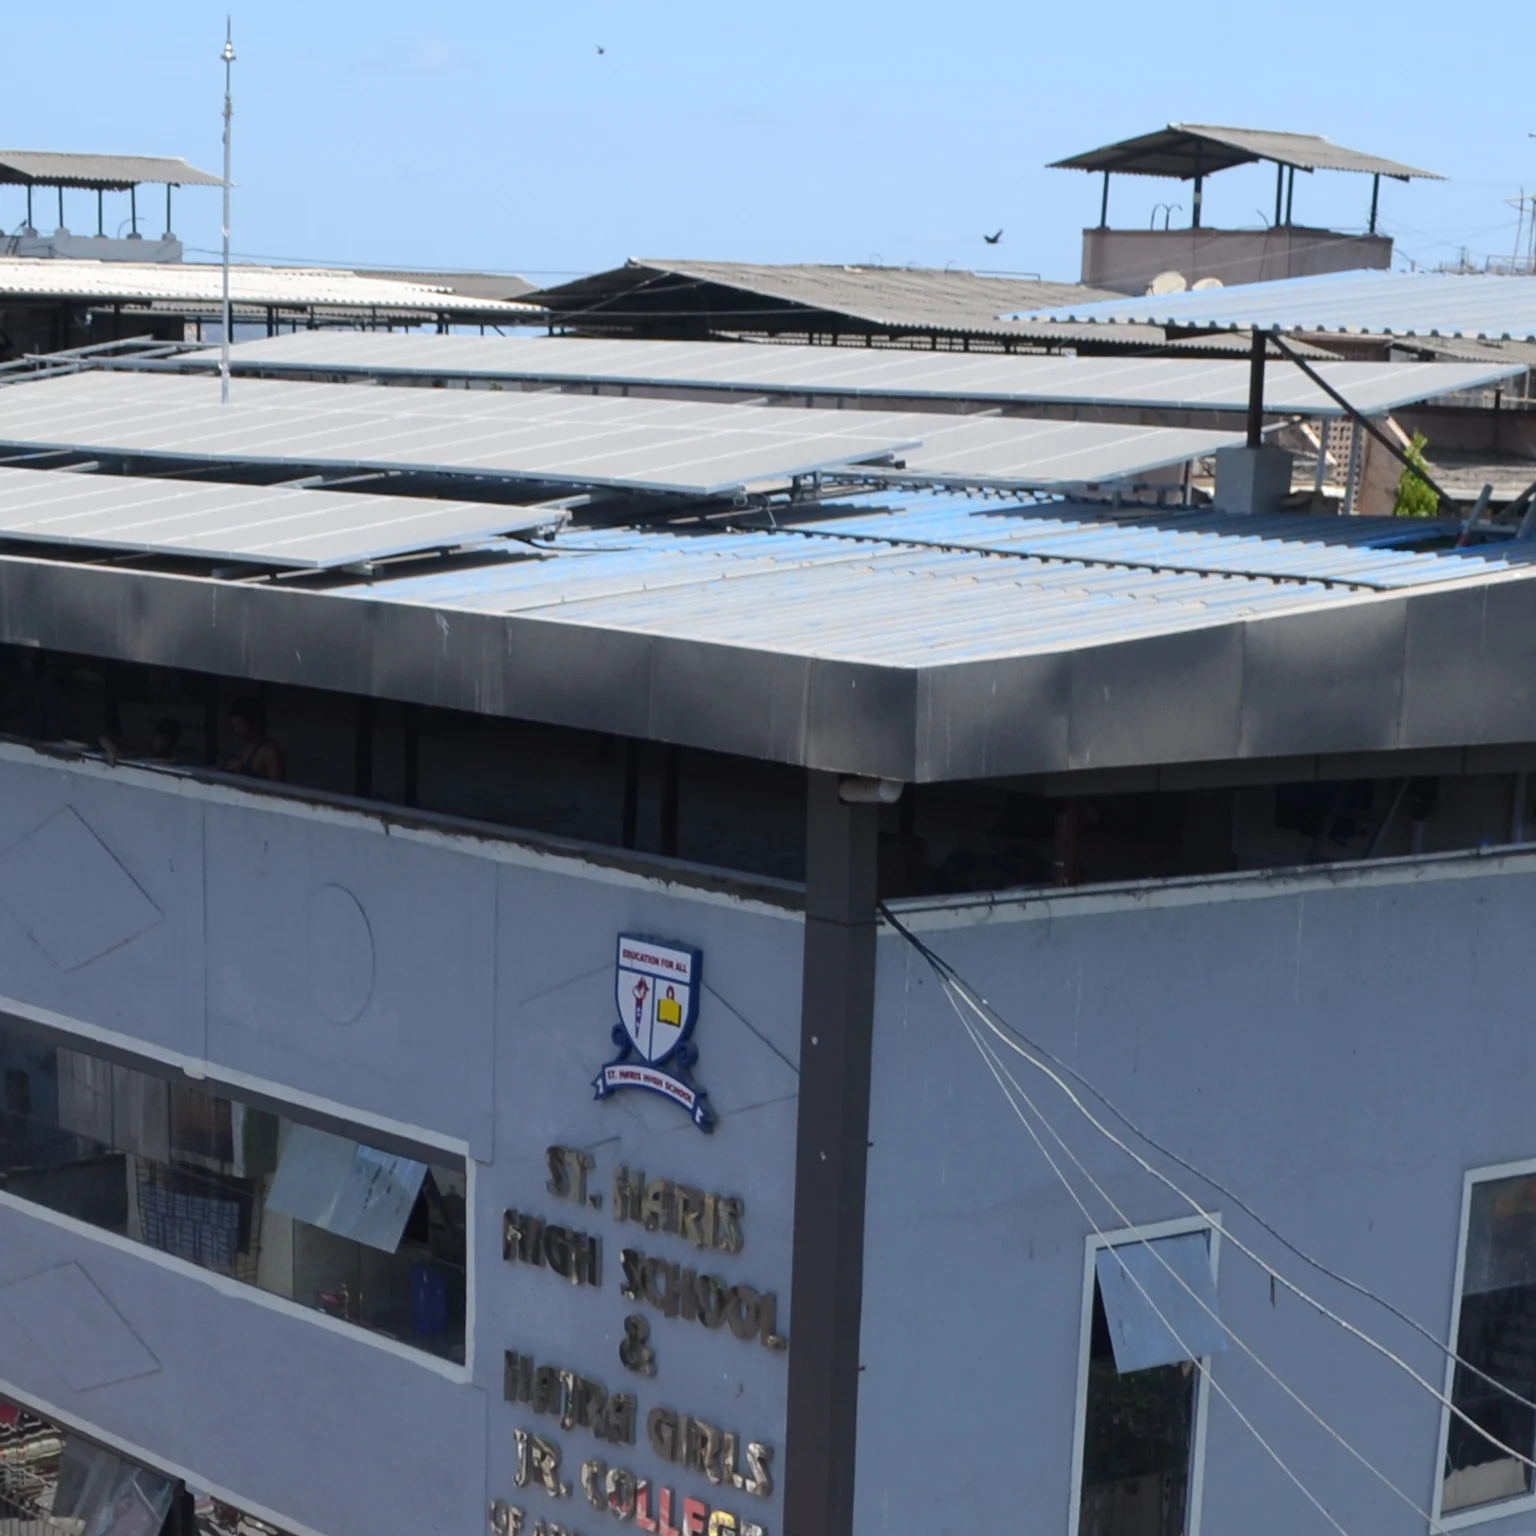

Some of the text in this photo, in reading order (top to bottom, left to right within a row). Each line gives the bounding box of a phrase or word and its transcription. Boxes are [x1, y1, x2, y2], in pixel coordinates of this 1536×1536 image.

[622, 949, 688, 974] EDUCATION FOR ALL
[665, 1082, 694, 1104] SCHOOL
[545, 1145, 745, 1254] ST. HARIS
[502, 1207, 788, 1352] HIGH SCHOOL
[619, 1313, 658, 1377] &
[512, 1427, 572, 1498] JR.
[646, 1406, 774, 1497] GIRLS
